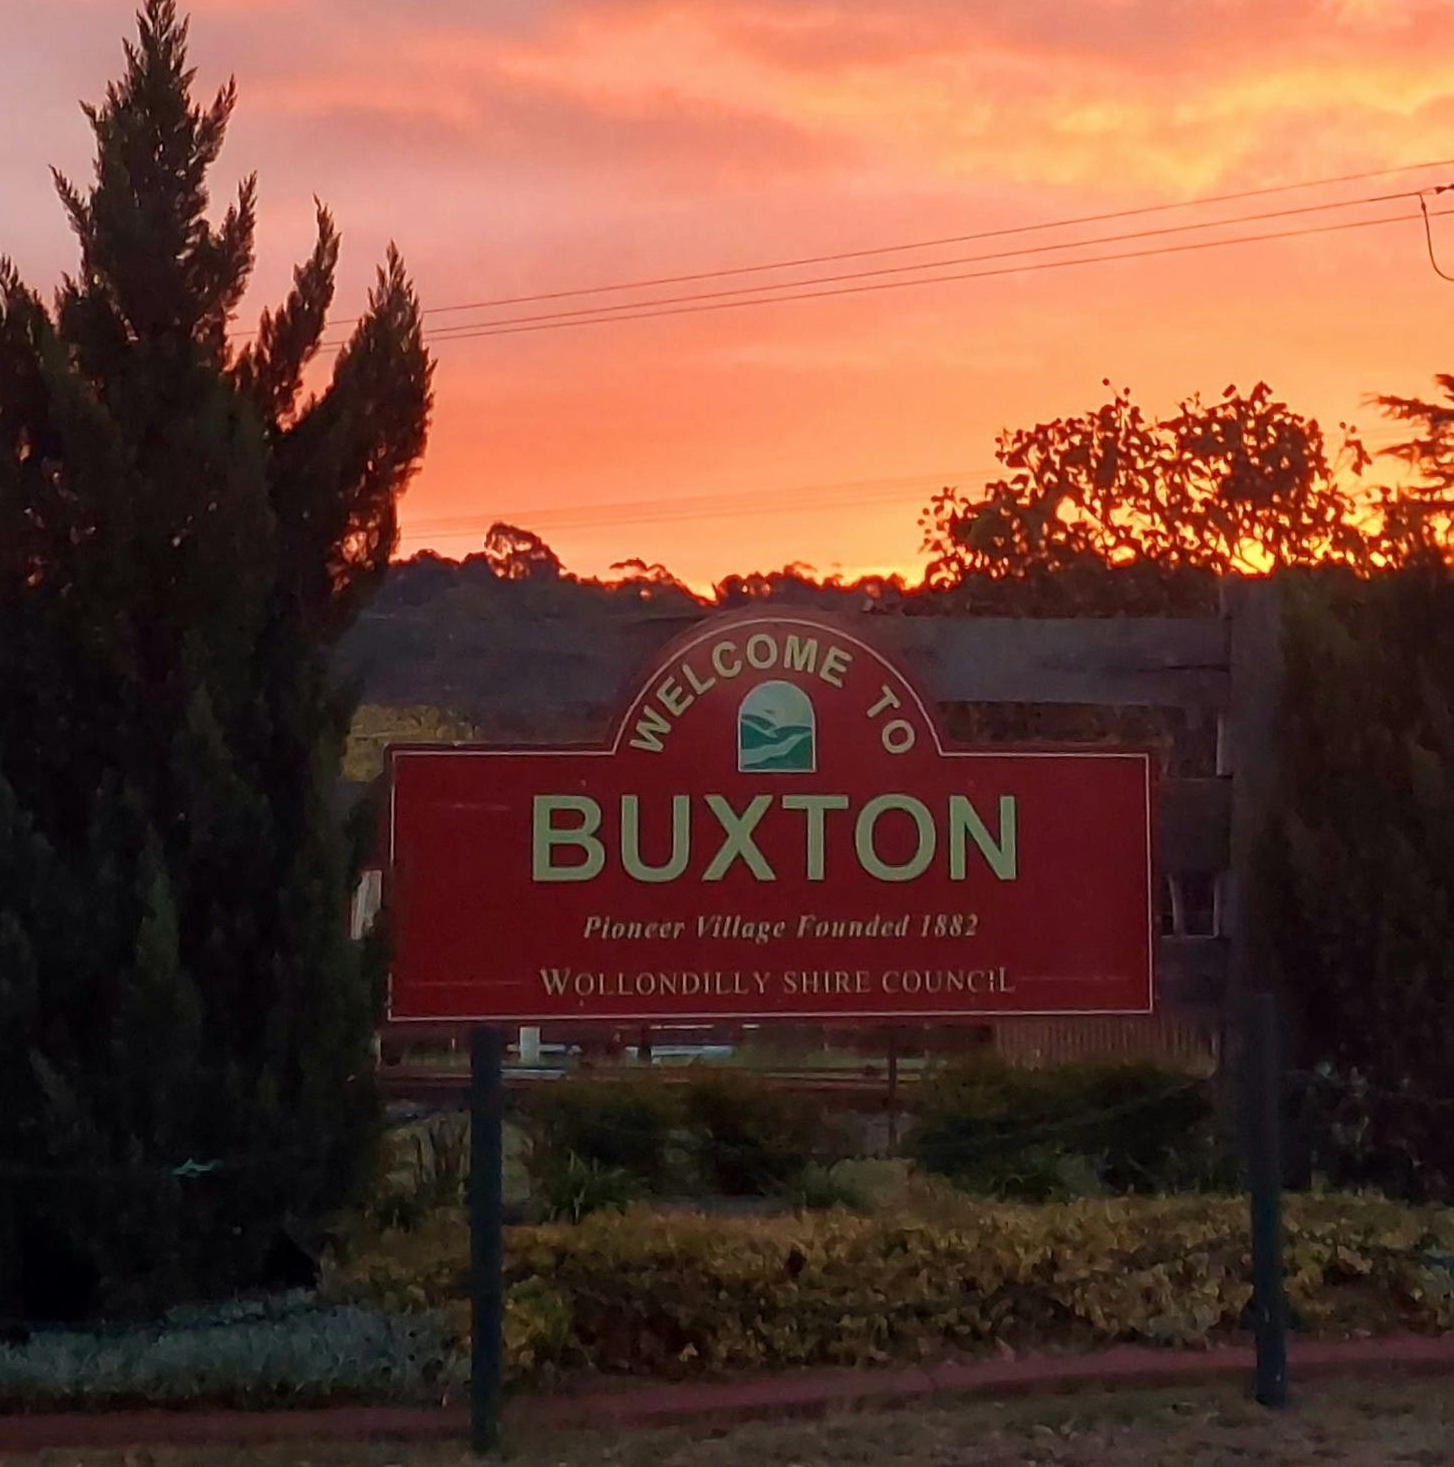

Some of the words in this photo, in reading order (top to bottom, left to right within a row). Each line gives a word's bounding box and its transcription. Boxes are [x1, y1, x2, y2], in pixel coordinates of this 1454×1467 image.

[629, 633, 853, 754] WELCOME
[867, 685, 915, 754] TO
[531, 794, 1018, 882] BUXTON
[583, 915, 685, 939] Pioneer
[696, 915, 787, 945] Village
[796, 914, 910, 938] Founded
[920, 913, 979, 936] 1882
[541, 968, 771, 995] WOLLONDILLY
[783, 970, 871, 995] SHIRE
[882, 968, 1016, 994] COUNCIL
